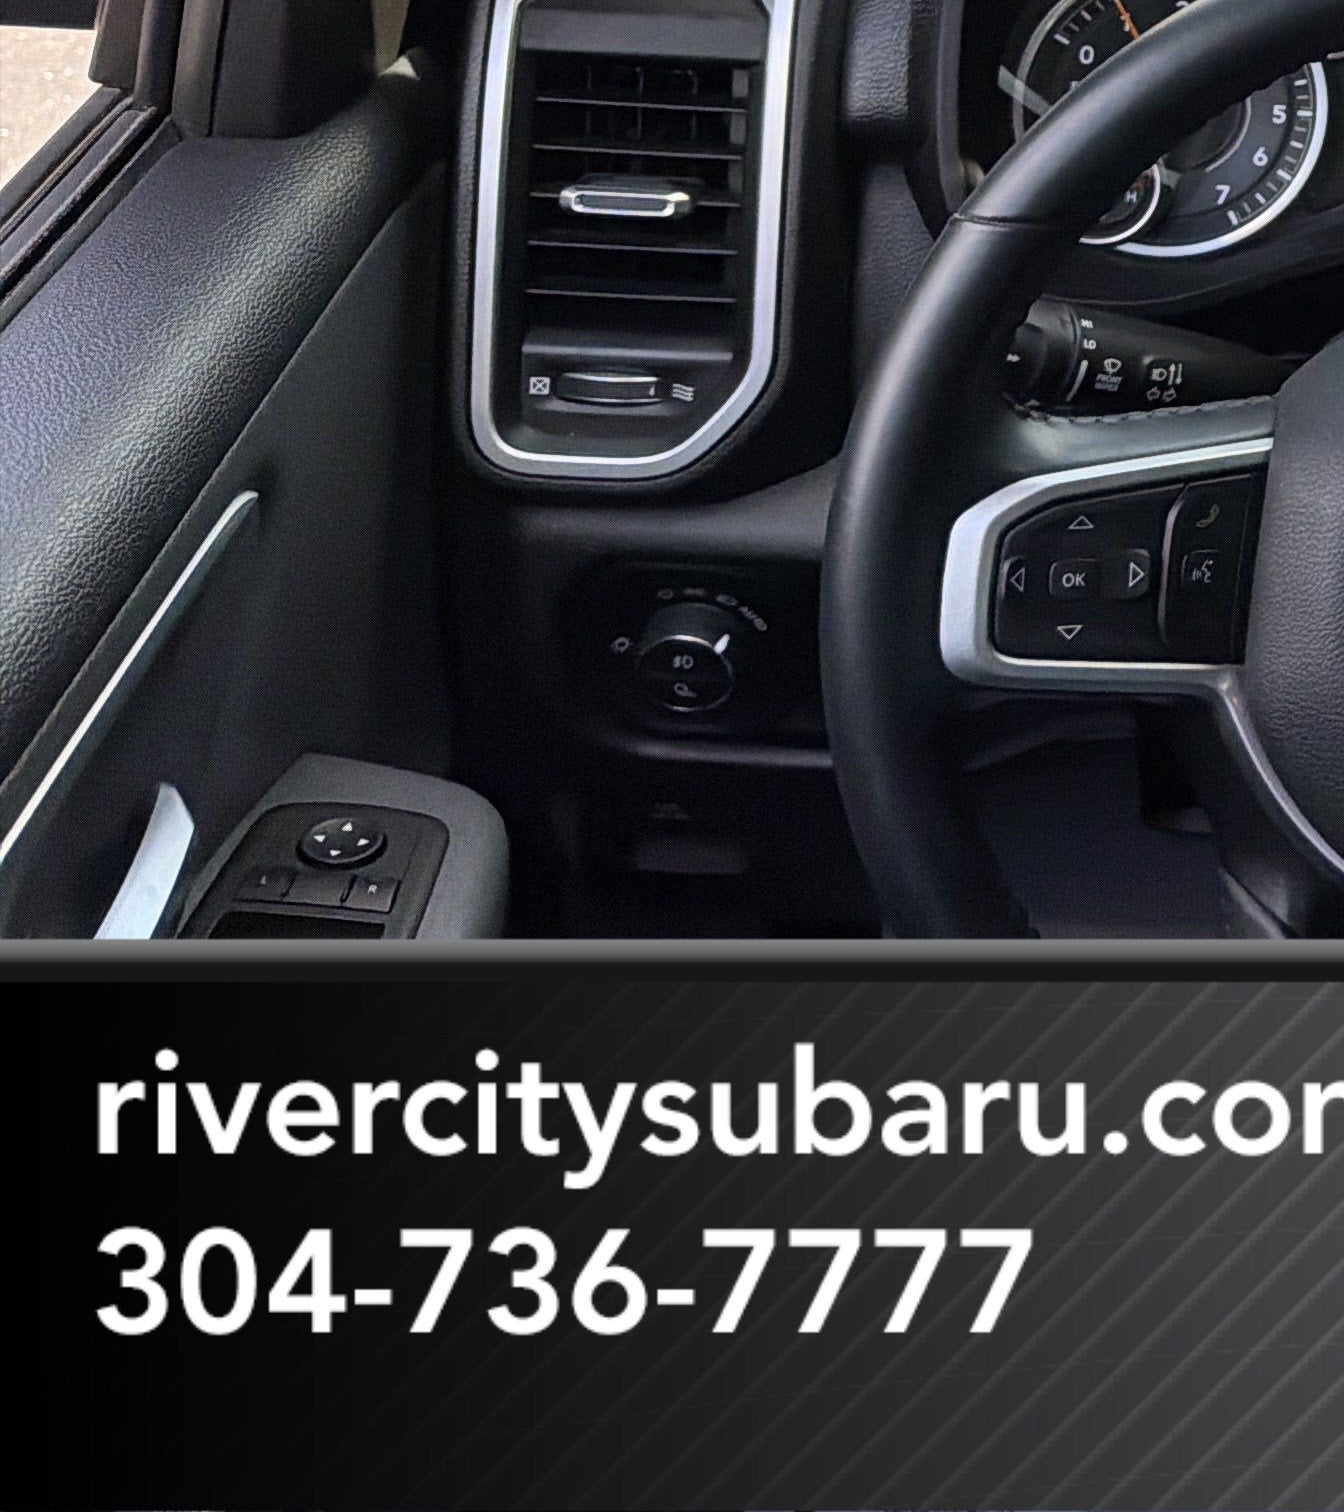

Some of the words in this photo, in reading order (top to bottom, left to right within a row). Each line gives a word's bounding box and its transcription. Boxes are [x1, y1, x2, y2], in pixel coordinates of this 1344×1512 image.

[1079, 45, 1094, 65] 0
[1272, 104, 1286, 123] 5
[1253, 147, 1268, 166] 6
[1215, 184, 1230, 205] 7
[1083, 338, 1097, 350] LO
[1061, 571, 1086, 588] OK
